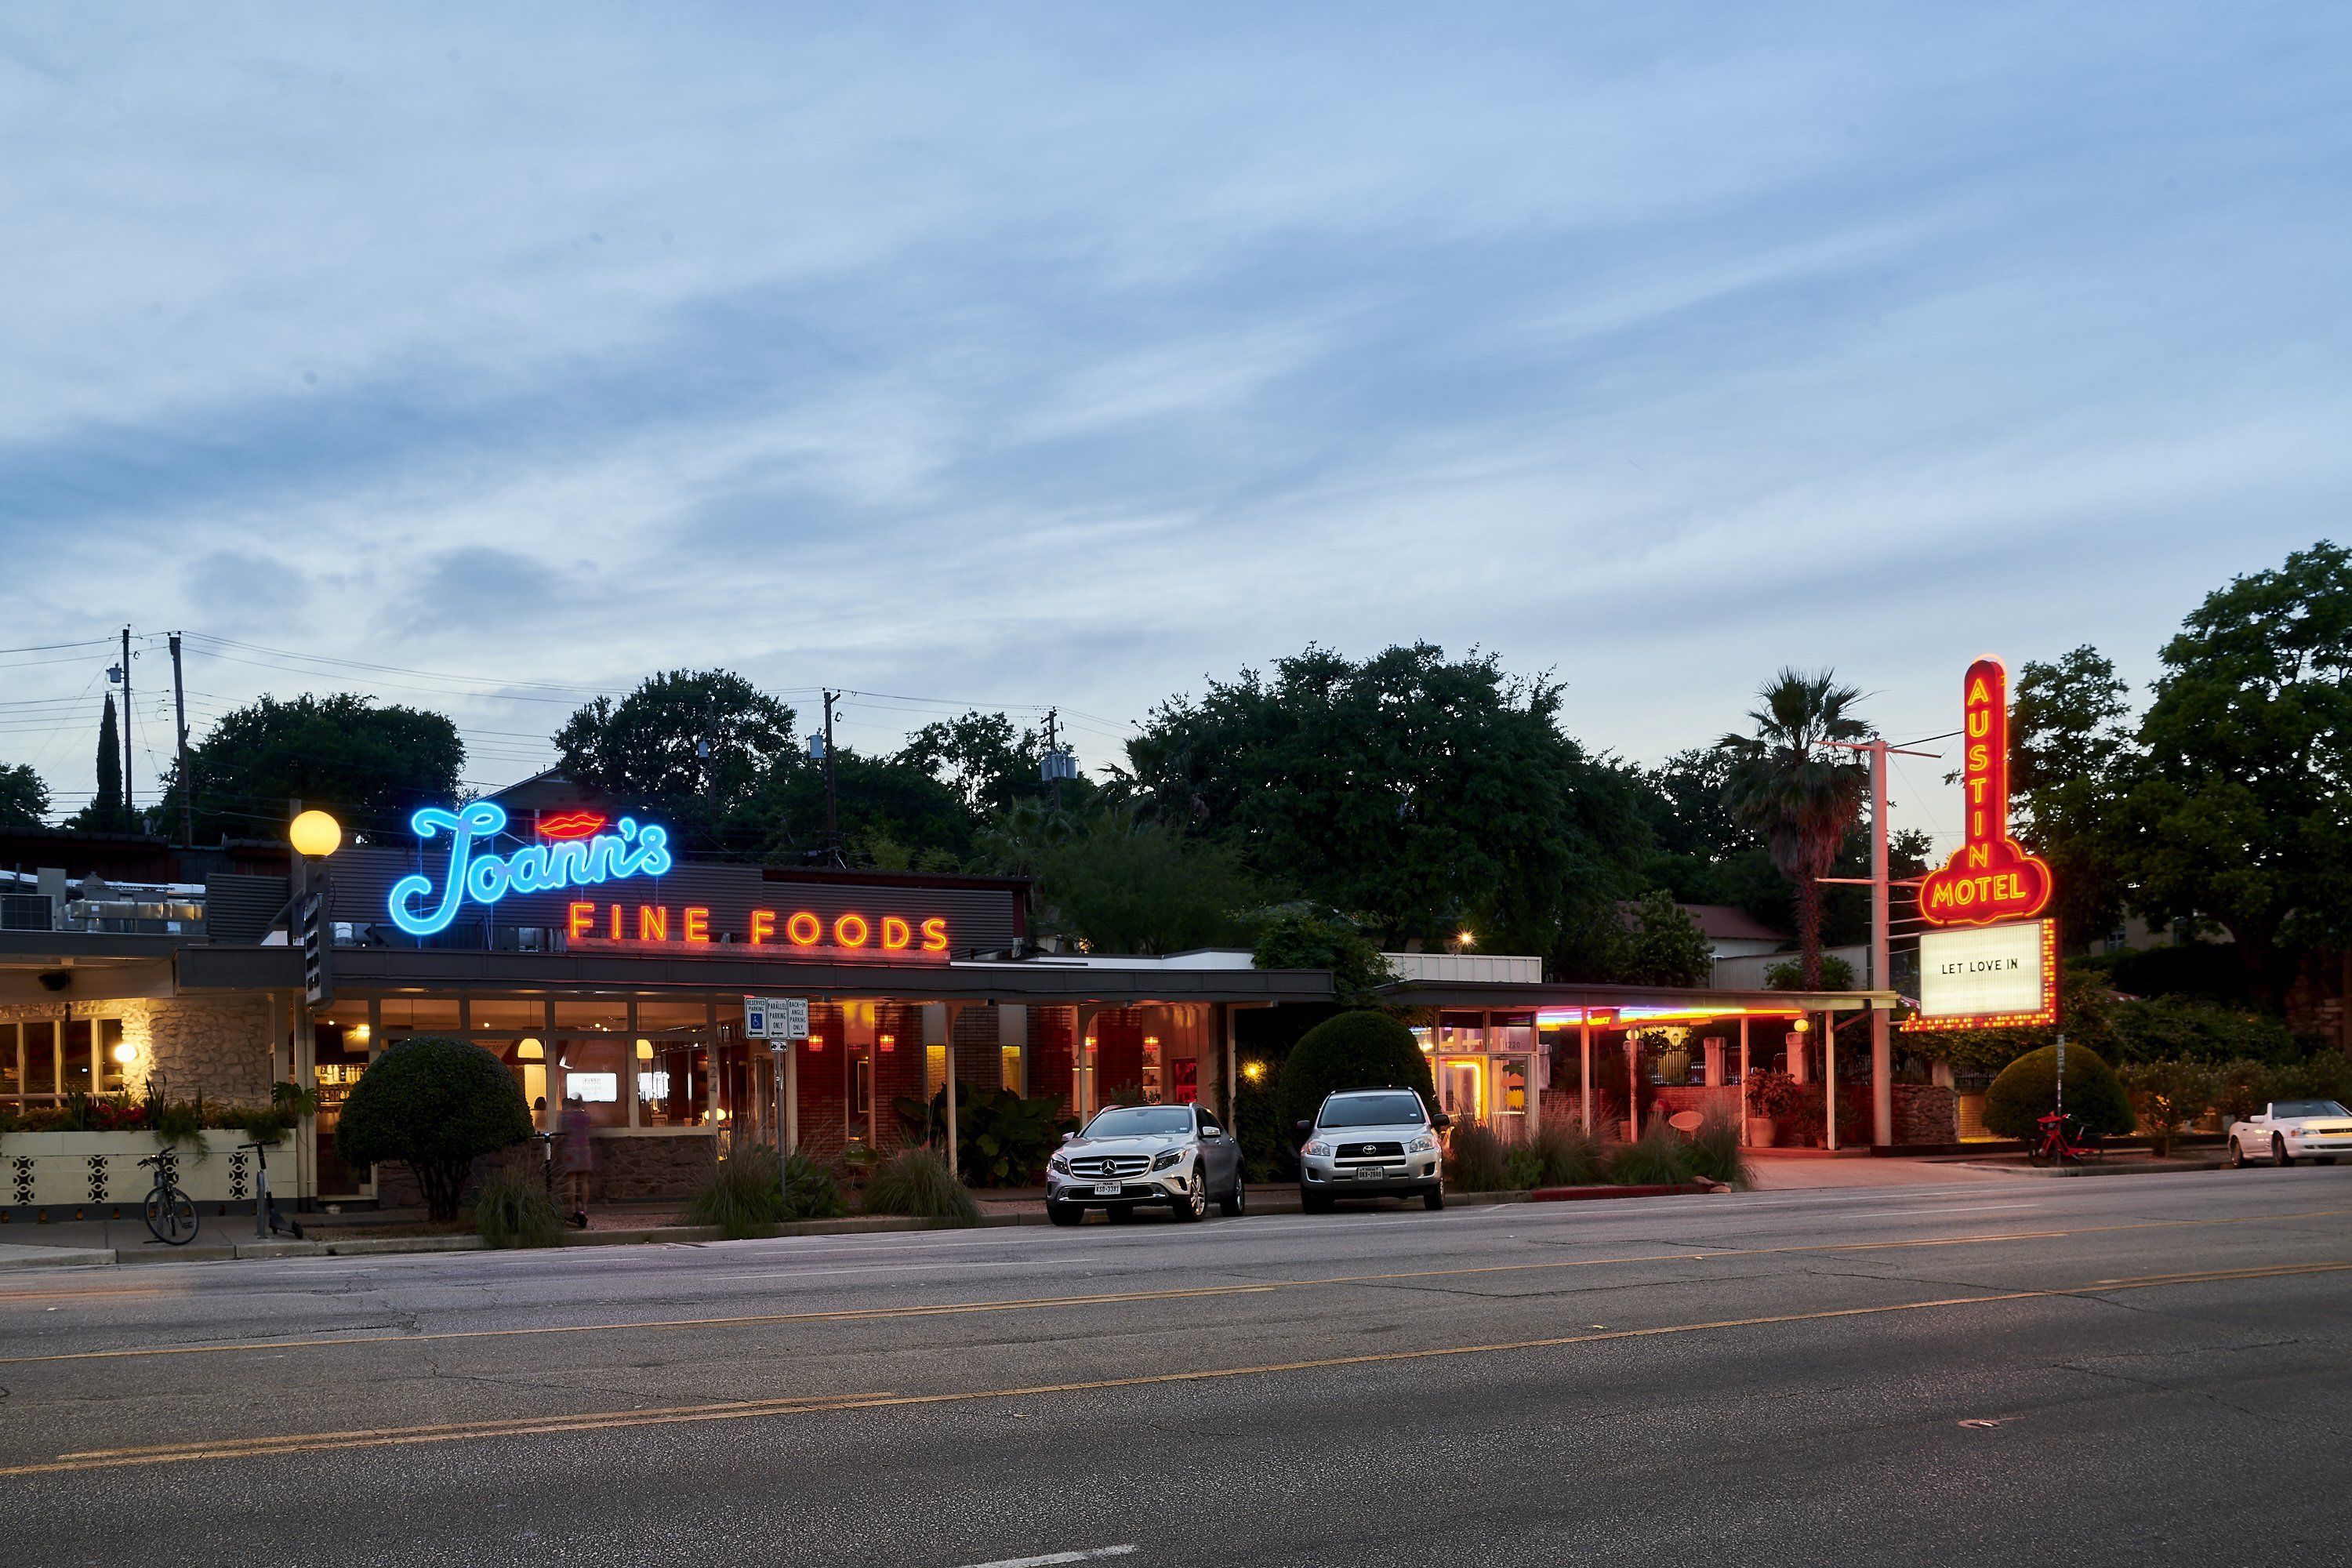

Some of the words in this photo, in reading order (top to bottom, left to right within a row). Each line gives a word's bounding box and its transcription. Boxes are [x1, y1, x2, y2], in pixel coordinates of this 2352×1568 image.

[1968, 677, 1990, 868] AUSTIN
[388, 801, 672, 935] Joann's
[1931, 873, 2027, 908] MOTEL
[569, 902, 710, 942] FINE
[750, 909, 948, 951] FOODS
[1942, 963, 1963, 975] LET
[1969, 960, 2002, 972] LOVE
[2007, 958, 2018, 970] IN
